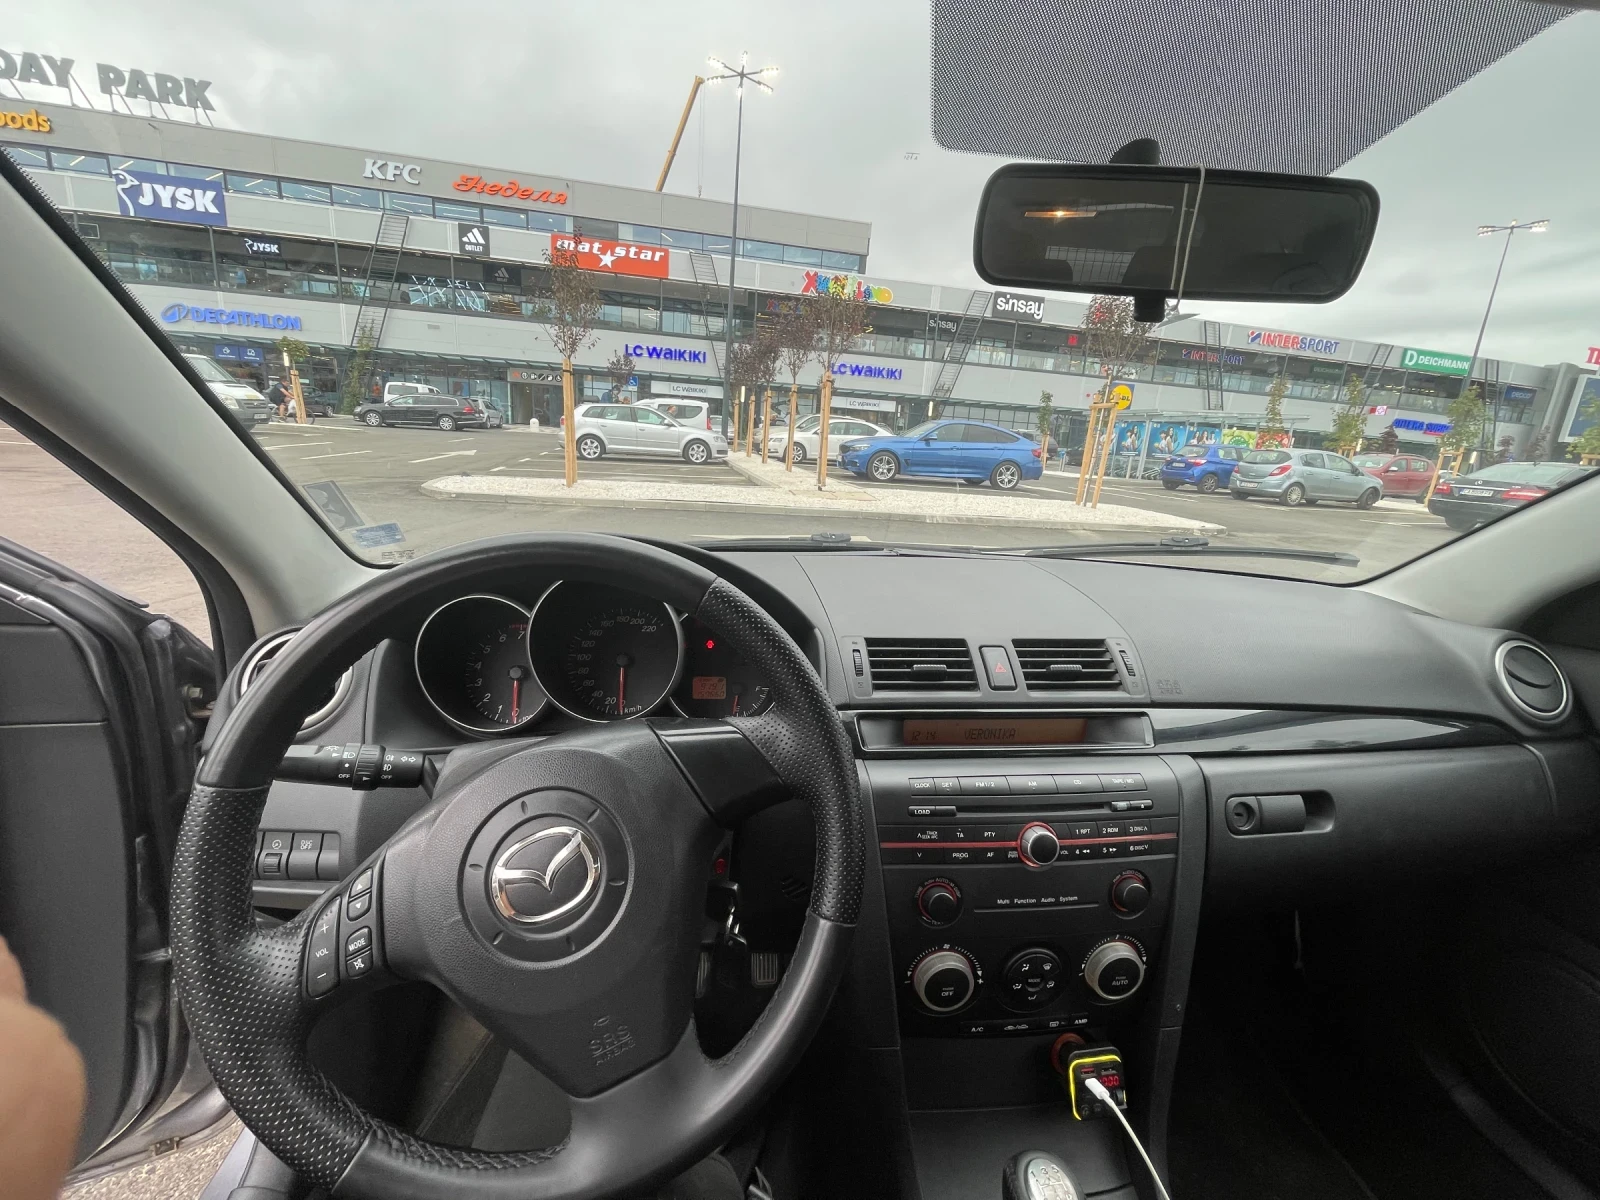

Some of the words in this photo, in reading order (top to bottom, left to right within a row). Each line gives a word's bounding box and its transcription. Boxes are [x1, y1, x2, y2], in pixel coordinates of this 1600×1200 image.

[96, 62, 216, 112] PARK
[363, 158, 421, 185] KFC
[452, 173, 568, 205] Неделя
[138, 182, 220, 214] JYSK
[252, 242, 280, 254] JYSK
[465, 244, 483, 252] OUTLET
[613, 246, 665, 262] star
[996, 294, 1044, 319] sinsay
[189, 306, 302, 331] DECATHLON
[929, 318, 957, 332] sinsay
[1259, 331, 1341, 354] INTERSPORT
[625, 344, 644, 357] LC
[1190, 350, 1246, 366] INTERSPORT
[1418, 355, 1470, 370] DEICHMANN
[831, 363, 847, 375] LC
[1511, 391, 1532, 399] pepco
[499, 633, 507, 642] 6
[517, 631, 525, 640] 7
[581, 640, 595, 648] 120
[474, 661, 482, 670] 4
[474, 678, 482, 687] 3
[483, 693, 491, 702] 2
[591, 690, 603, 698] 40
[604, 697, 617, 705] 20
[498, 704, 503, 713] 1
[624, 705, 642, 714] km/h
[964, 728, 1016, 740] VERONIKA
[348, 937, 366, 952] MODE
[315, 947, 329, 958] VOL
[1111, 979, 1129, 987] AUTO
[590, 1025, 631, 1054] SRS
[595, 1040, 636, 1066] AIRBAG
[1030, 1169, 1036, 1178] 1
[1040, 1166, 1048, 1175] 3
